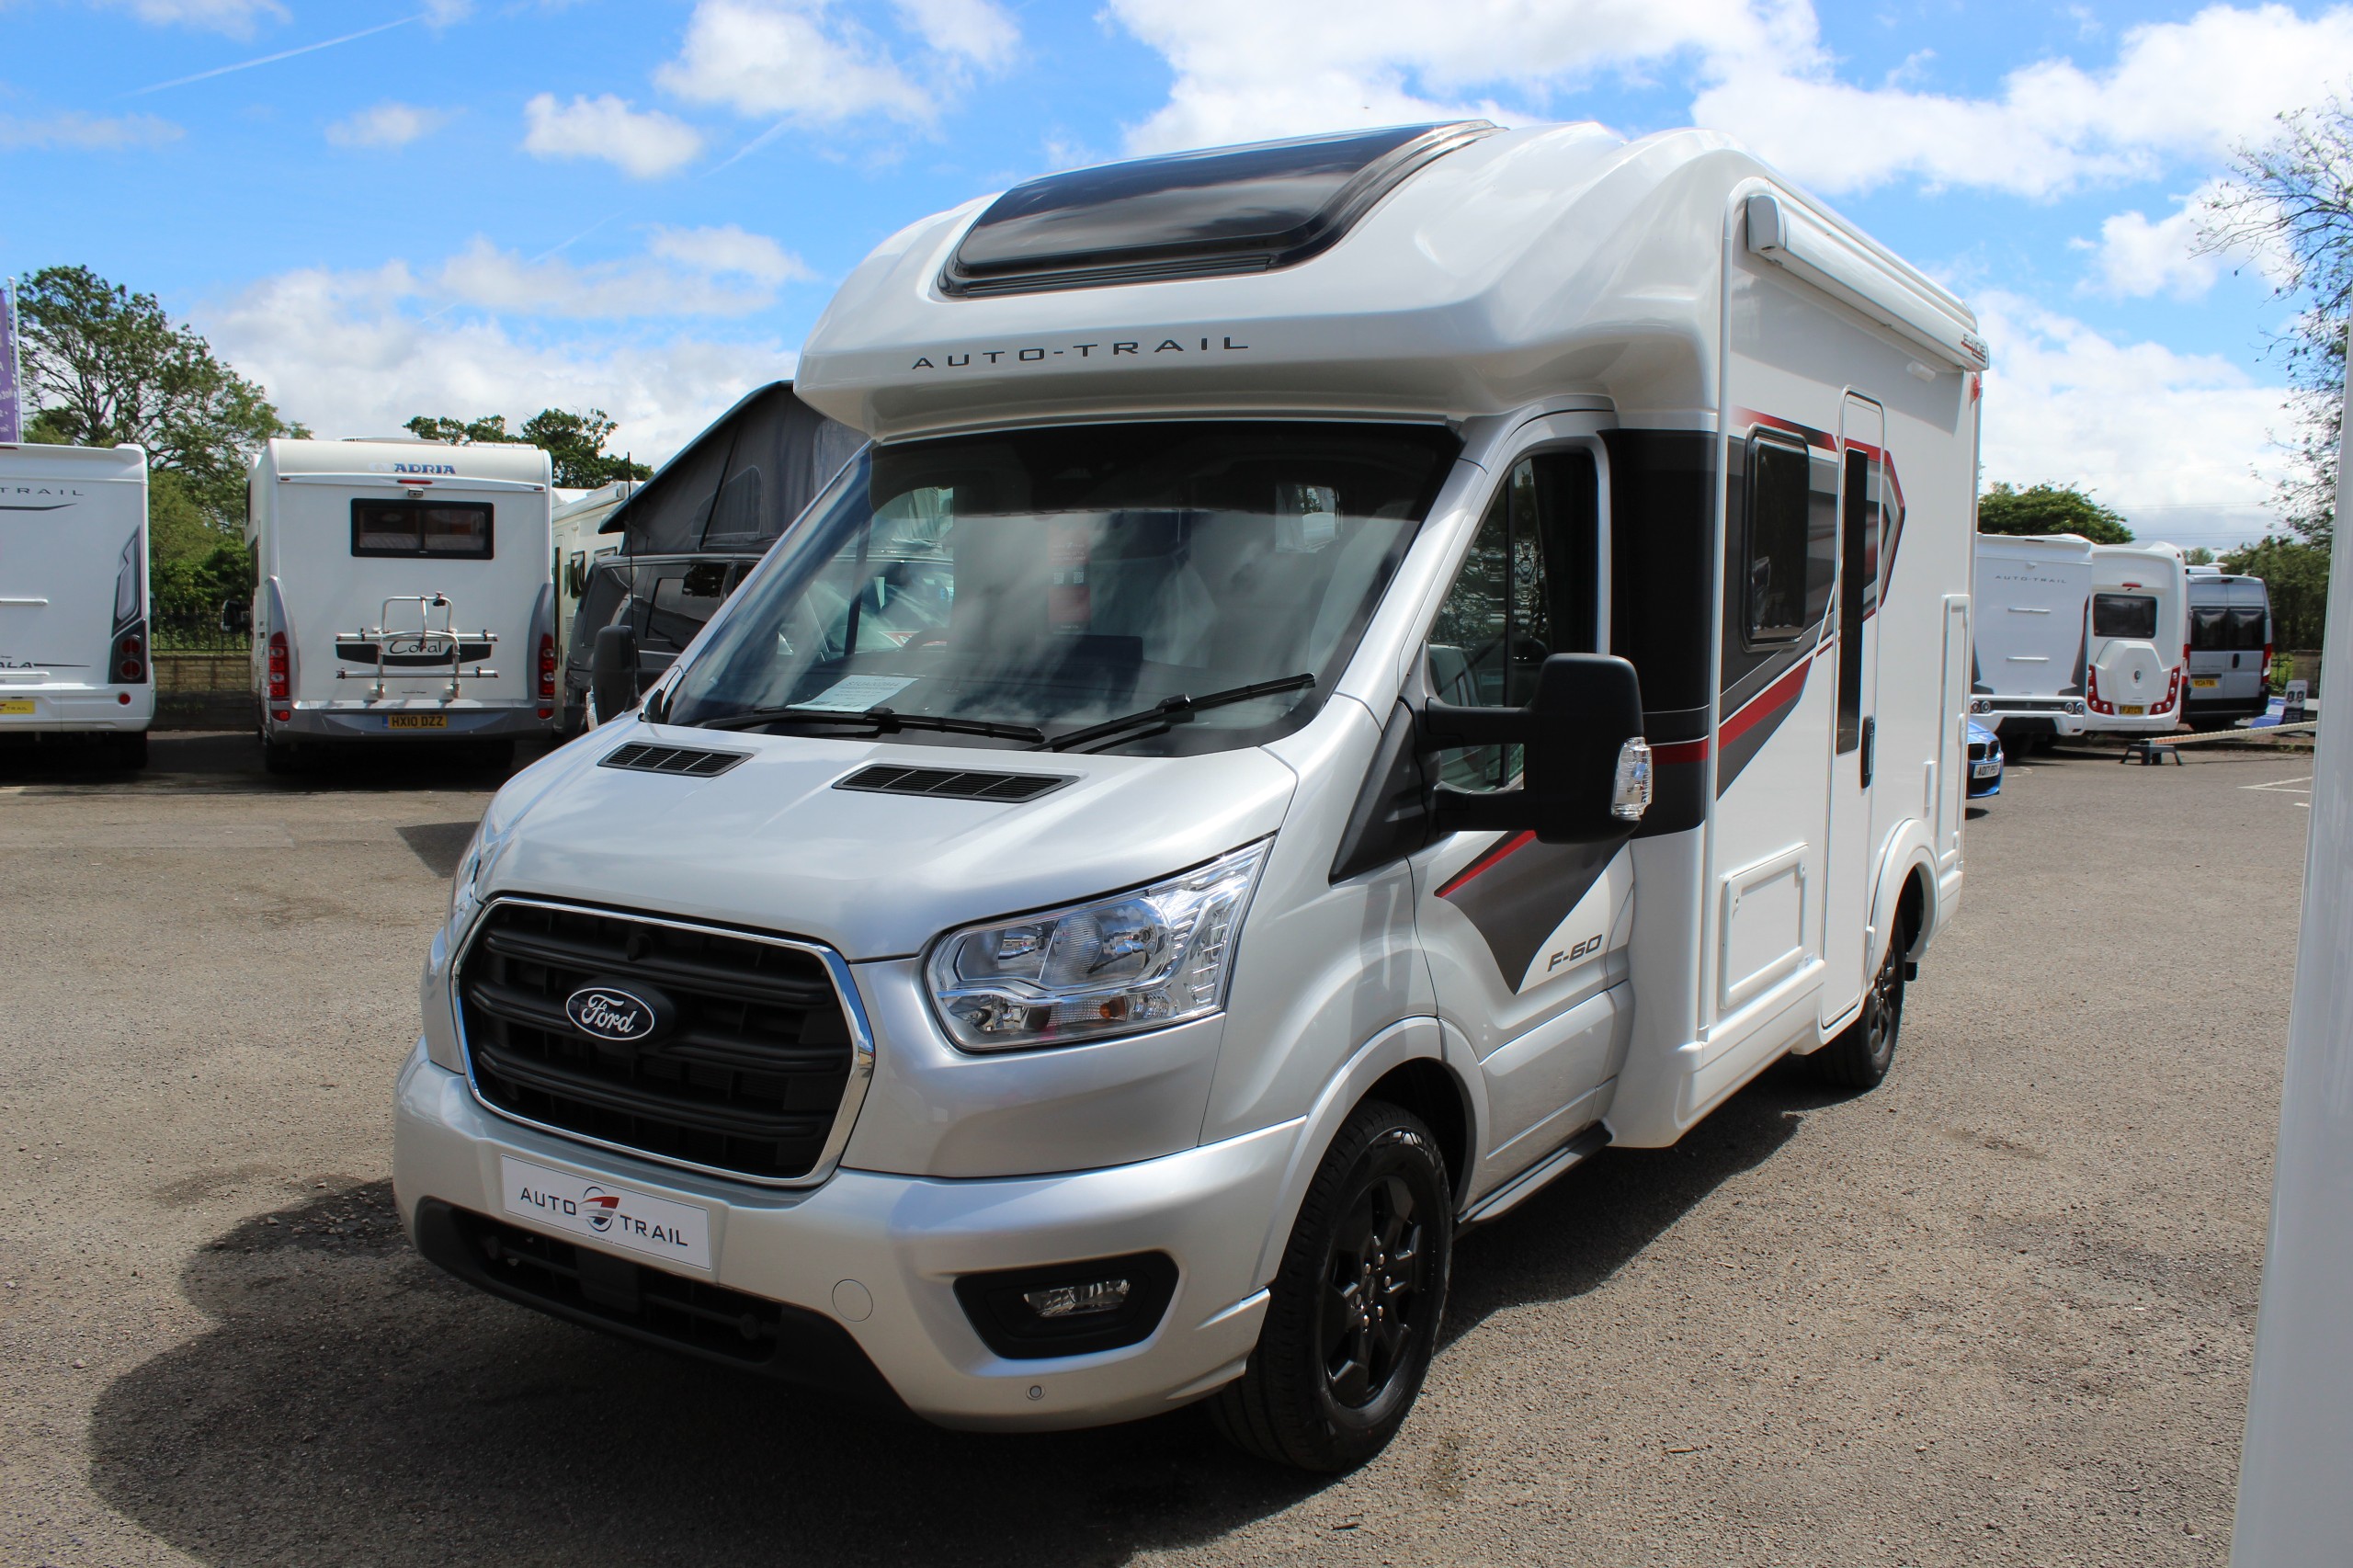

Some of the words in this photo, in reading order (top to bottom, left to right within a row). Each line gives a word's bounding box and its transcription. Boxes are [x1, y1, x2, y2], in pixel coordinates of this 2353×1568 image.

[912, 336, 1249, 369] AUTO-TRAIL
[393, 462, 457, 475] ADRIA
[1995, 575, 2067, 584] AUTO-TRAIL
[392, 716, 418, 727] HX10
[420, 716, 444, 727] DZZ
[1547, 934, 1603, 972] F-60
[581, 994, 638, 1033] Ford
[520, 1187, 577, 1216] AUTO
[620, 1214, 688, 1247] TRAIL
